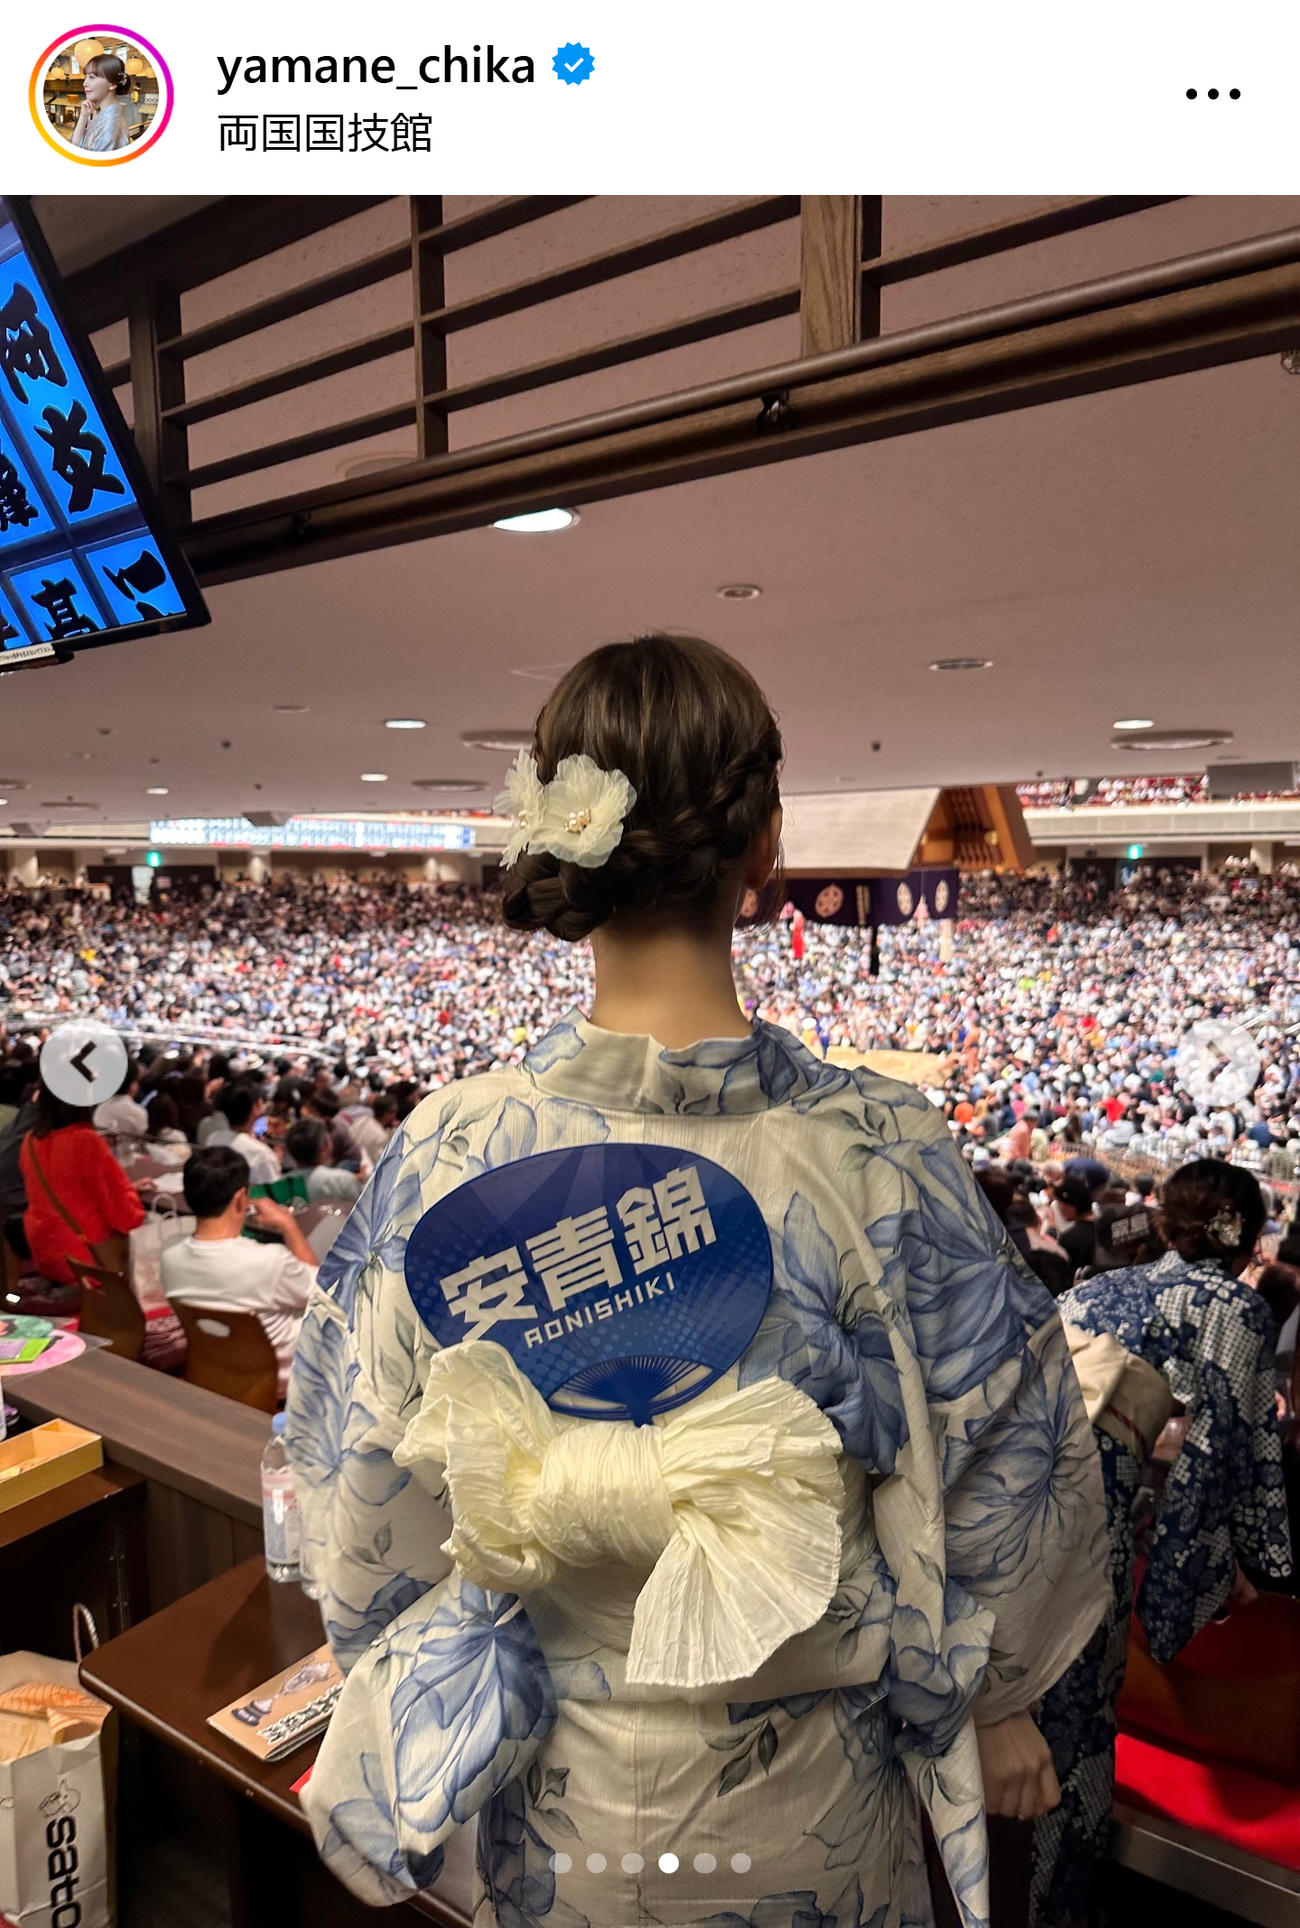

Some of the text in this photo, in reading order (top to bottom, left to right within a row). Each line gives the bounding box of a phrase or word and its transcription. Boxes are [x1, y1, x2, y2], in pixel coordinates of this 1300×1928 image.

[439, 1164, 717, 1341] 安青錦
[523, 1271, 676, 1349] AONISHIKI
